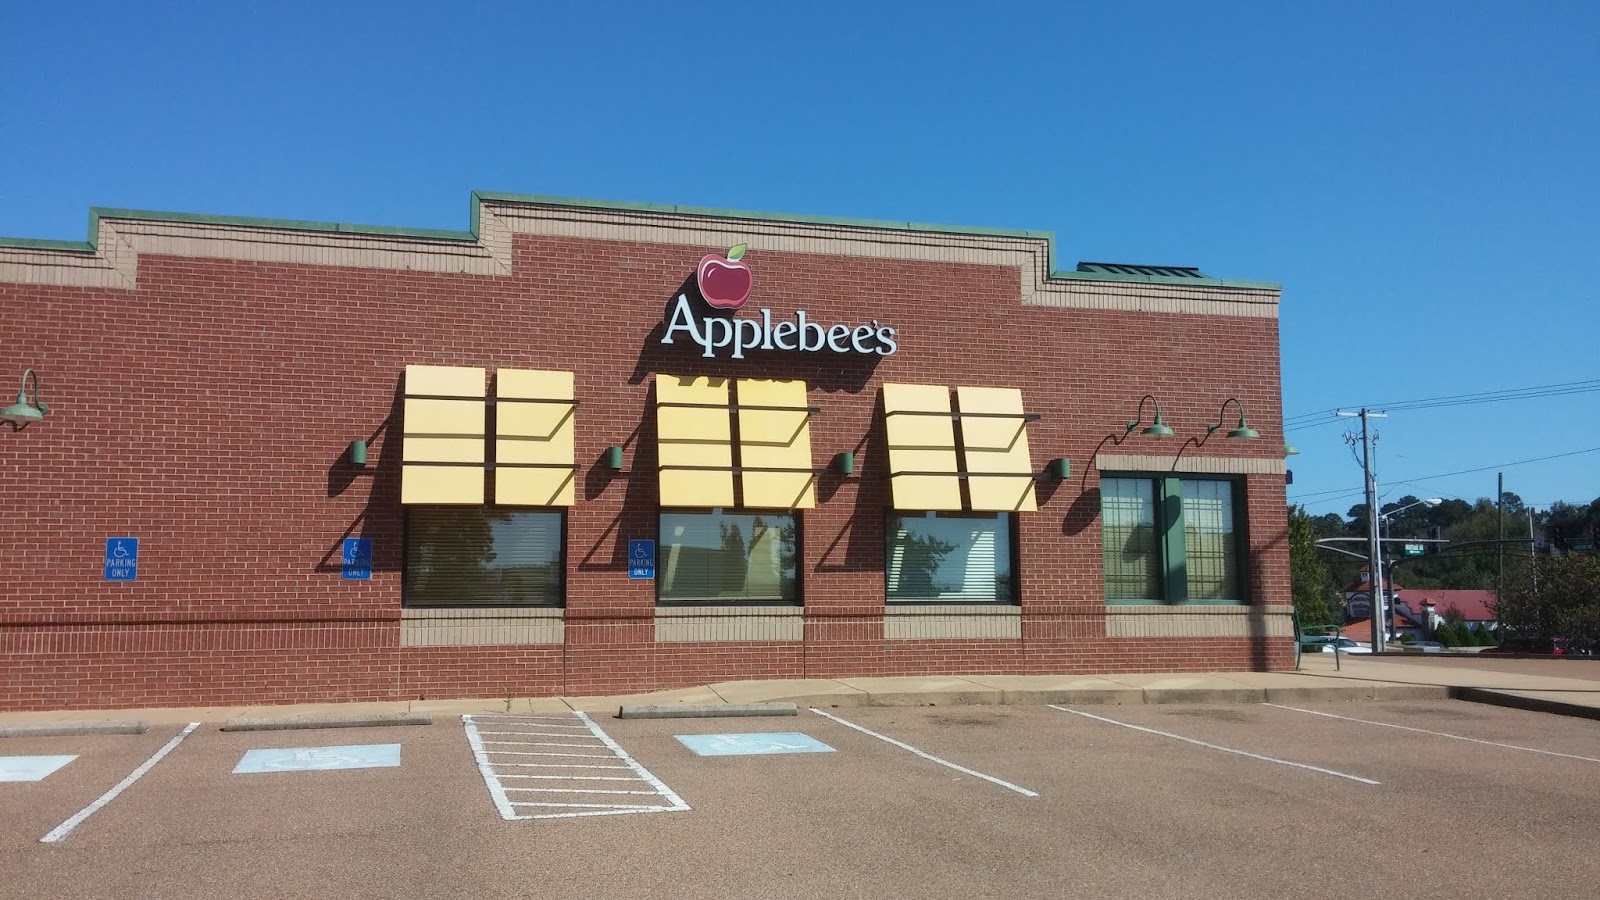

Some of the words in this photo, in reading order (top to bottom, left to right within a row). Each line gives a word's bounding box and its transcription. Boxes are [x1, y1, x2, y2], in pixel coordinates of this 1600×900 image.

[660, 293, 898, 359] Applebee's
[106, 558, 136, 567] PARKING
[629, 558, 654, 567] PARKING
[111, 568, 130, 578] ONLY
[348, 567, 365, 577] ONLY
[633, 567, 649, 576] ONLY
